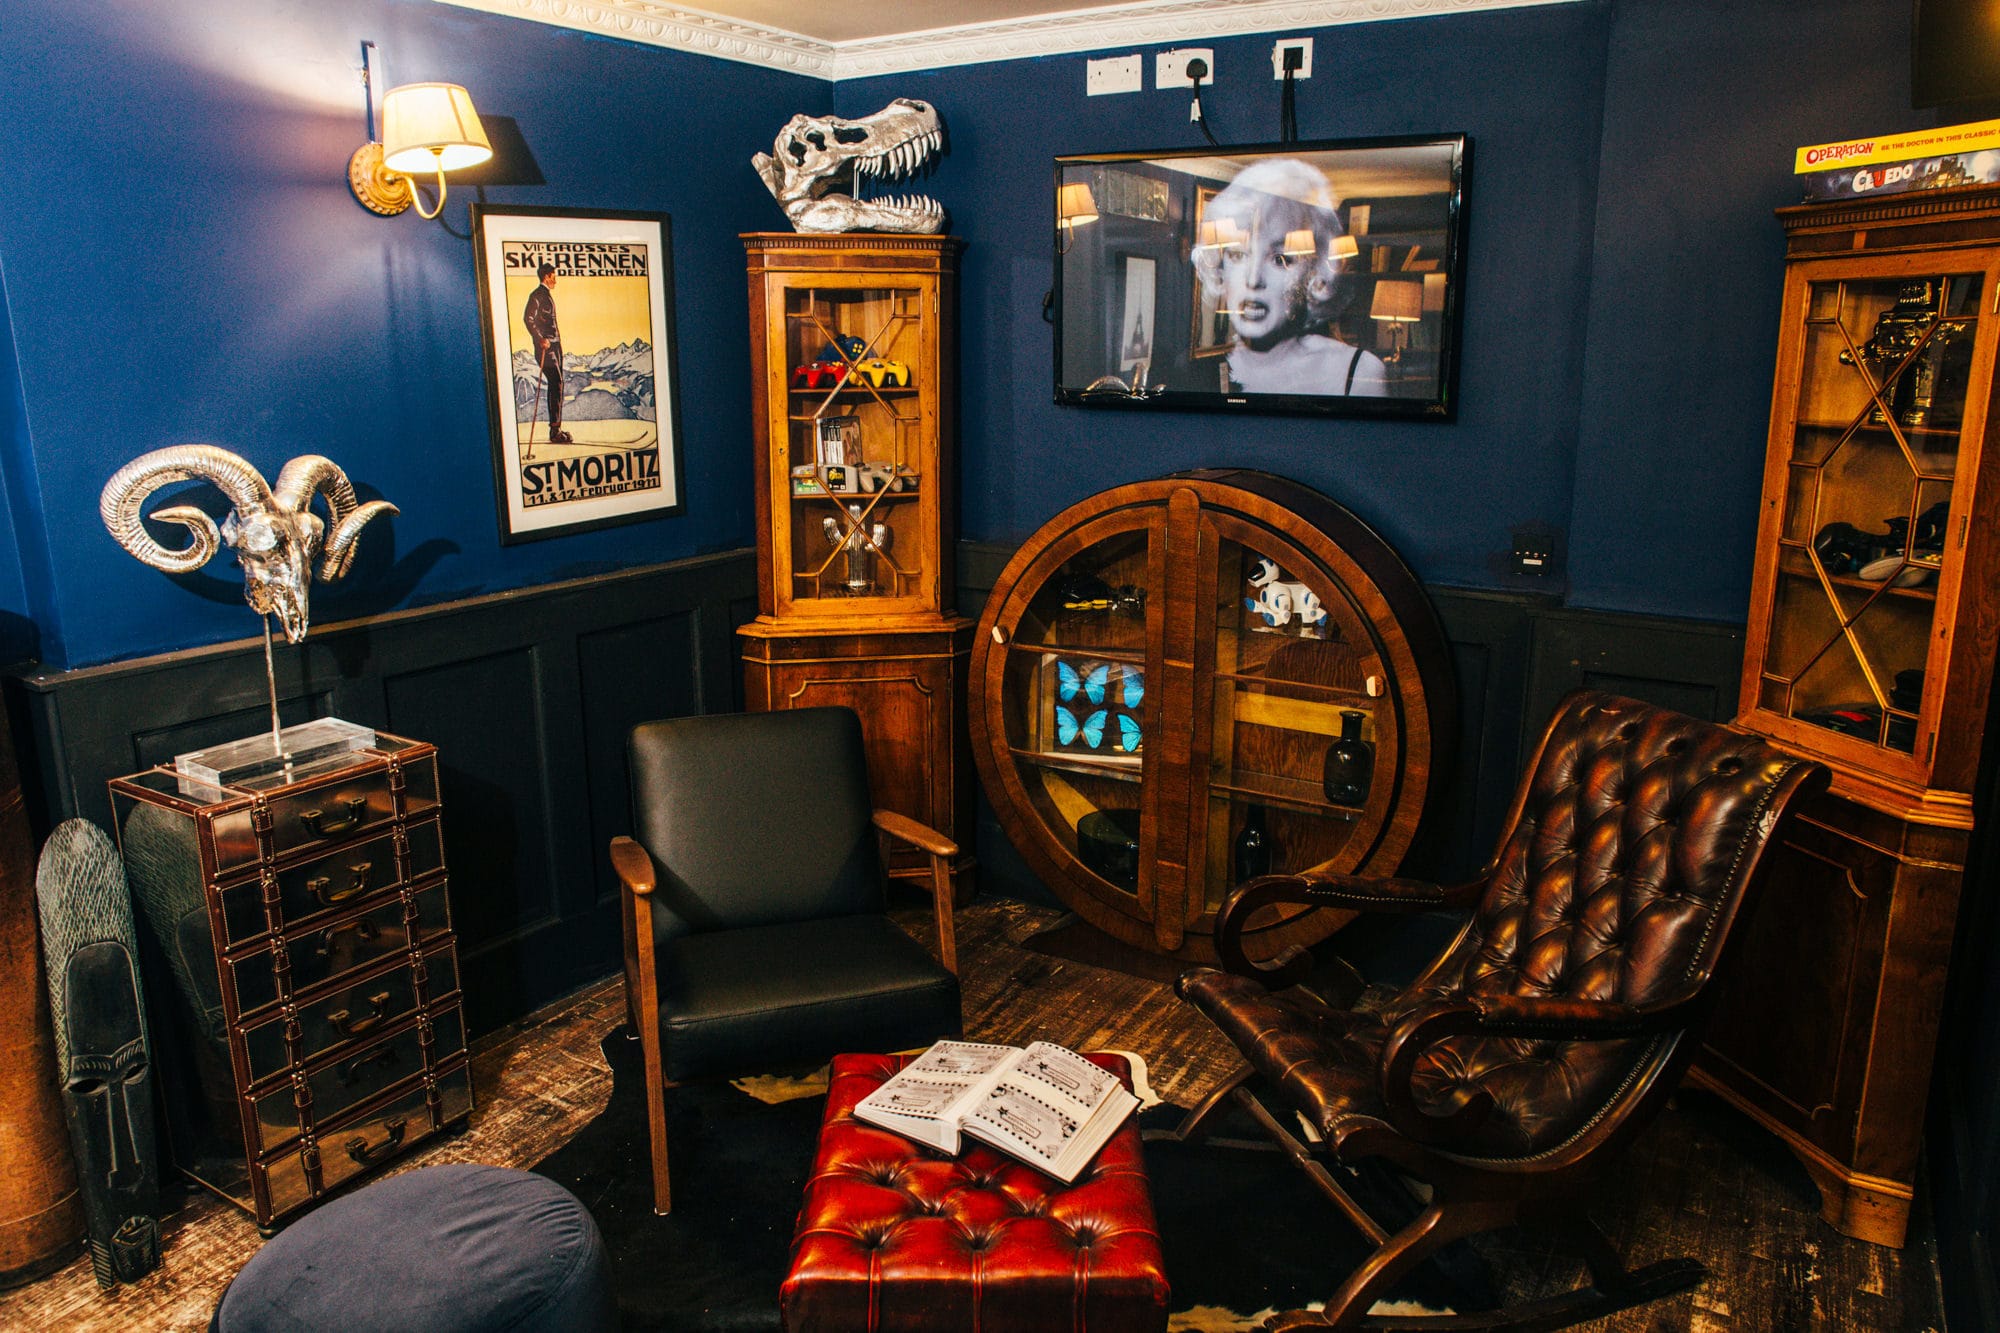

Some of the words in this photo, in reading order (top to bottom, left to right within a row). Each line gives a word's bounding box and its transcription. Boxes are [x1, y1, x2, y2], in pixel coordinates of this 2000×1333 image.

[1805, 143, 1874, 165] OPERATION
[1906, 138, 1934, 147] DOCTOR
[1946, 134, 1962, 142] THIS
[1964, 129, 1997, 139] CLASSIC
[1852, 164, 1914, 193] CLUEDO
[546, 244, 631, 253] GROSSES
[557, 269, 585, 277] DER
[589, 269, 648, 277] SCHWEIZ
[558, 450, 659, 491] MORITZ
[632, 478, 657, 489] 1911
